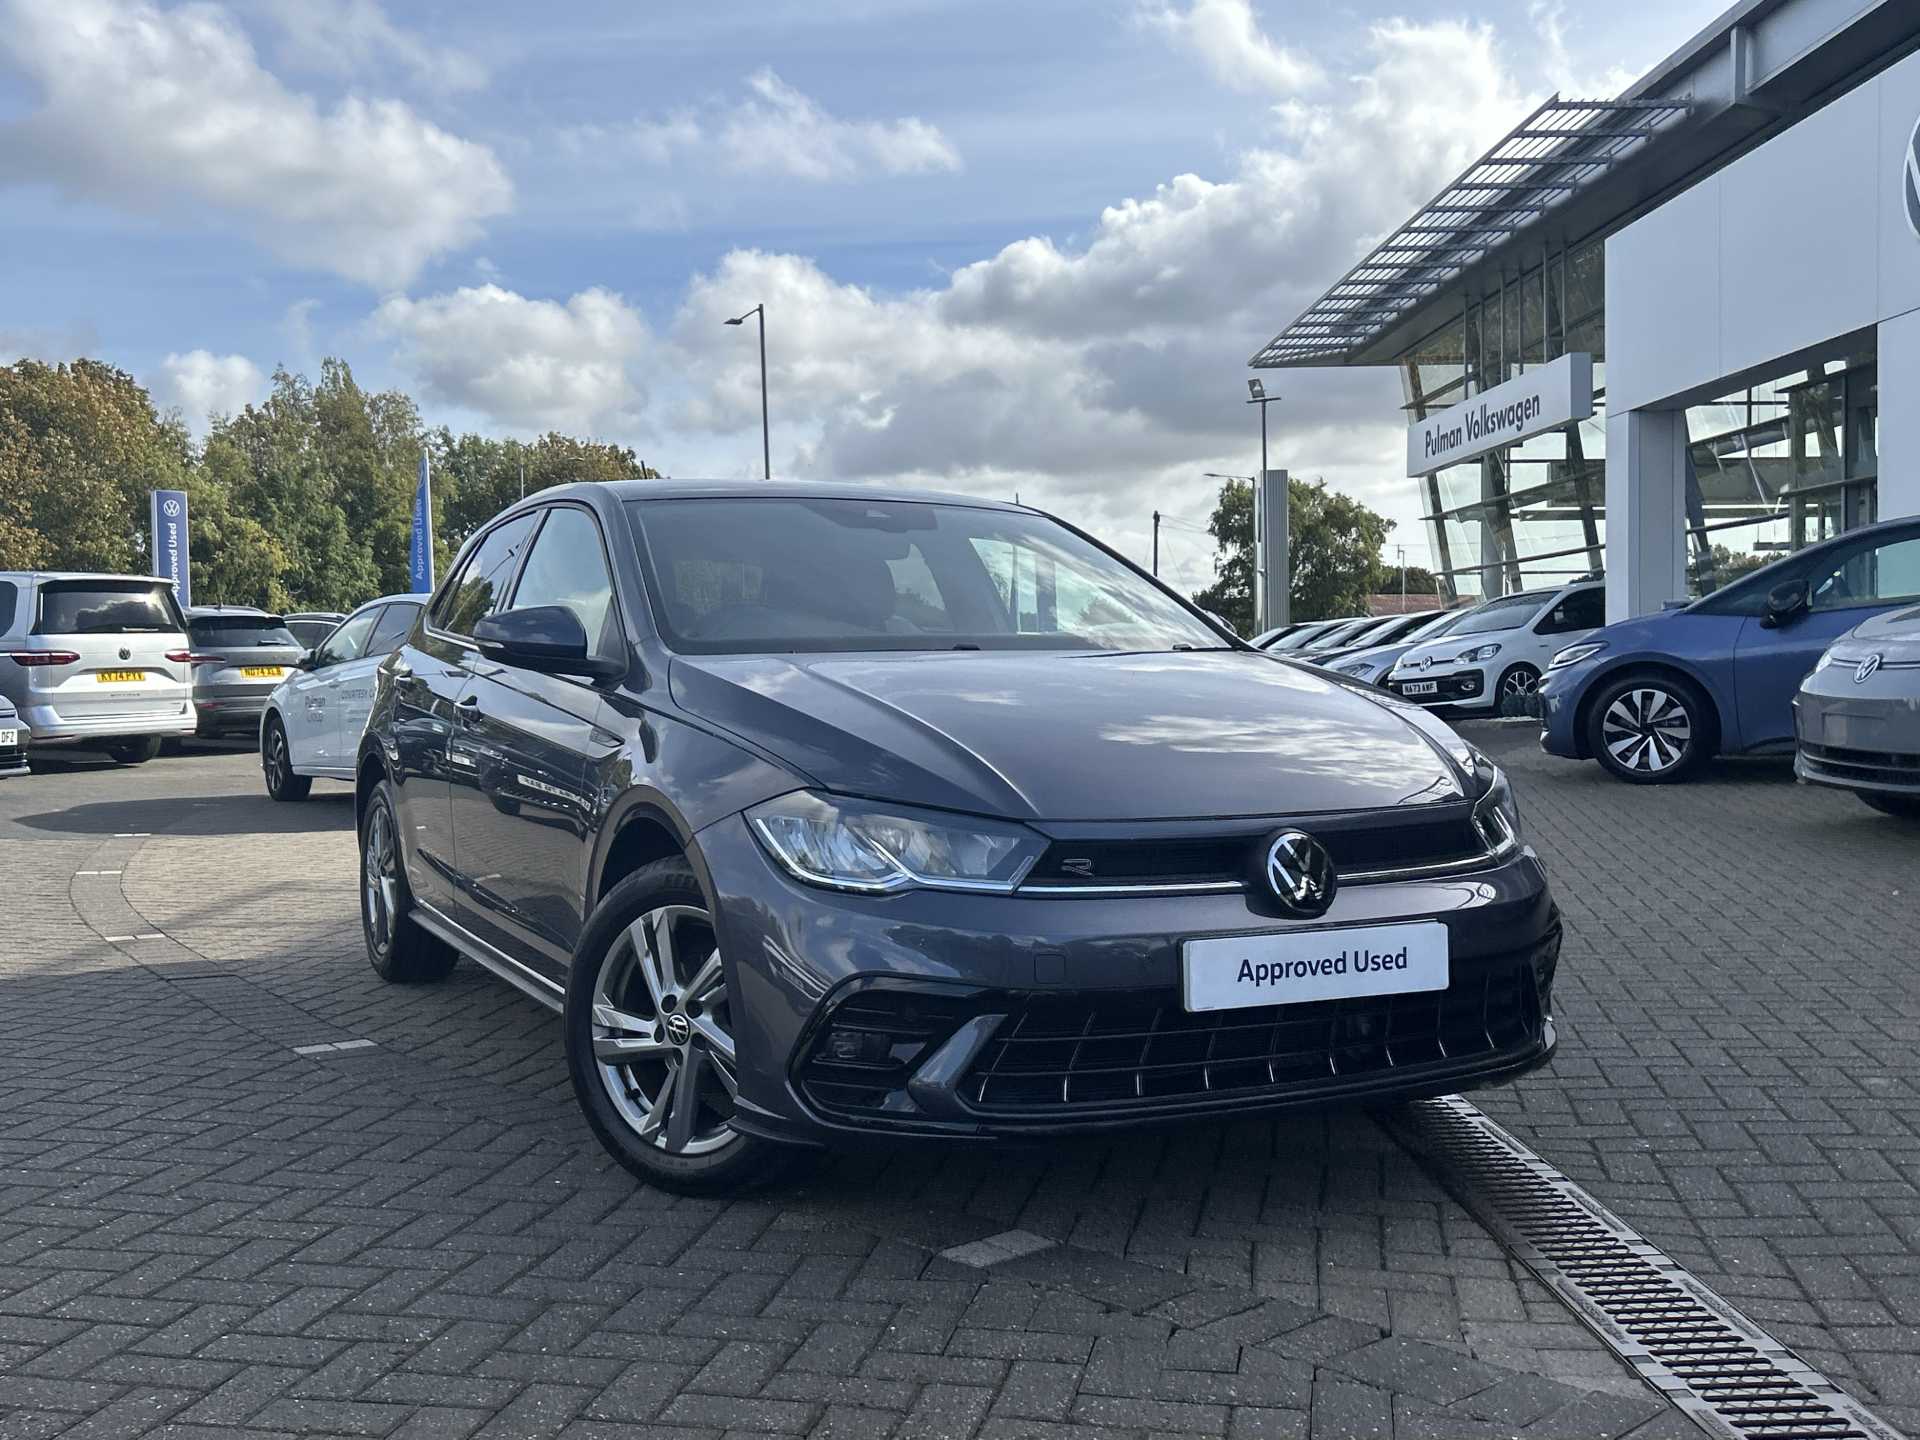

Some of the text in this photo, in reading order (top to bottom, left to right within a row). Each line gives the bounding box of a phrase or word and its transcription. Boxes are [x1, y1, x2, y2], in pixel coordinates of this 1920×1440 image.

[1425, 394, 1540, 458] Pulman Volkswagen
[168, 522, 177, 548] Used
[414, 498, 424, 580] Approved Used
[1237, 946, 1408, 987] Approved Used
